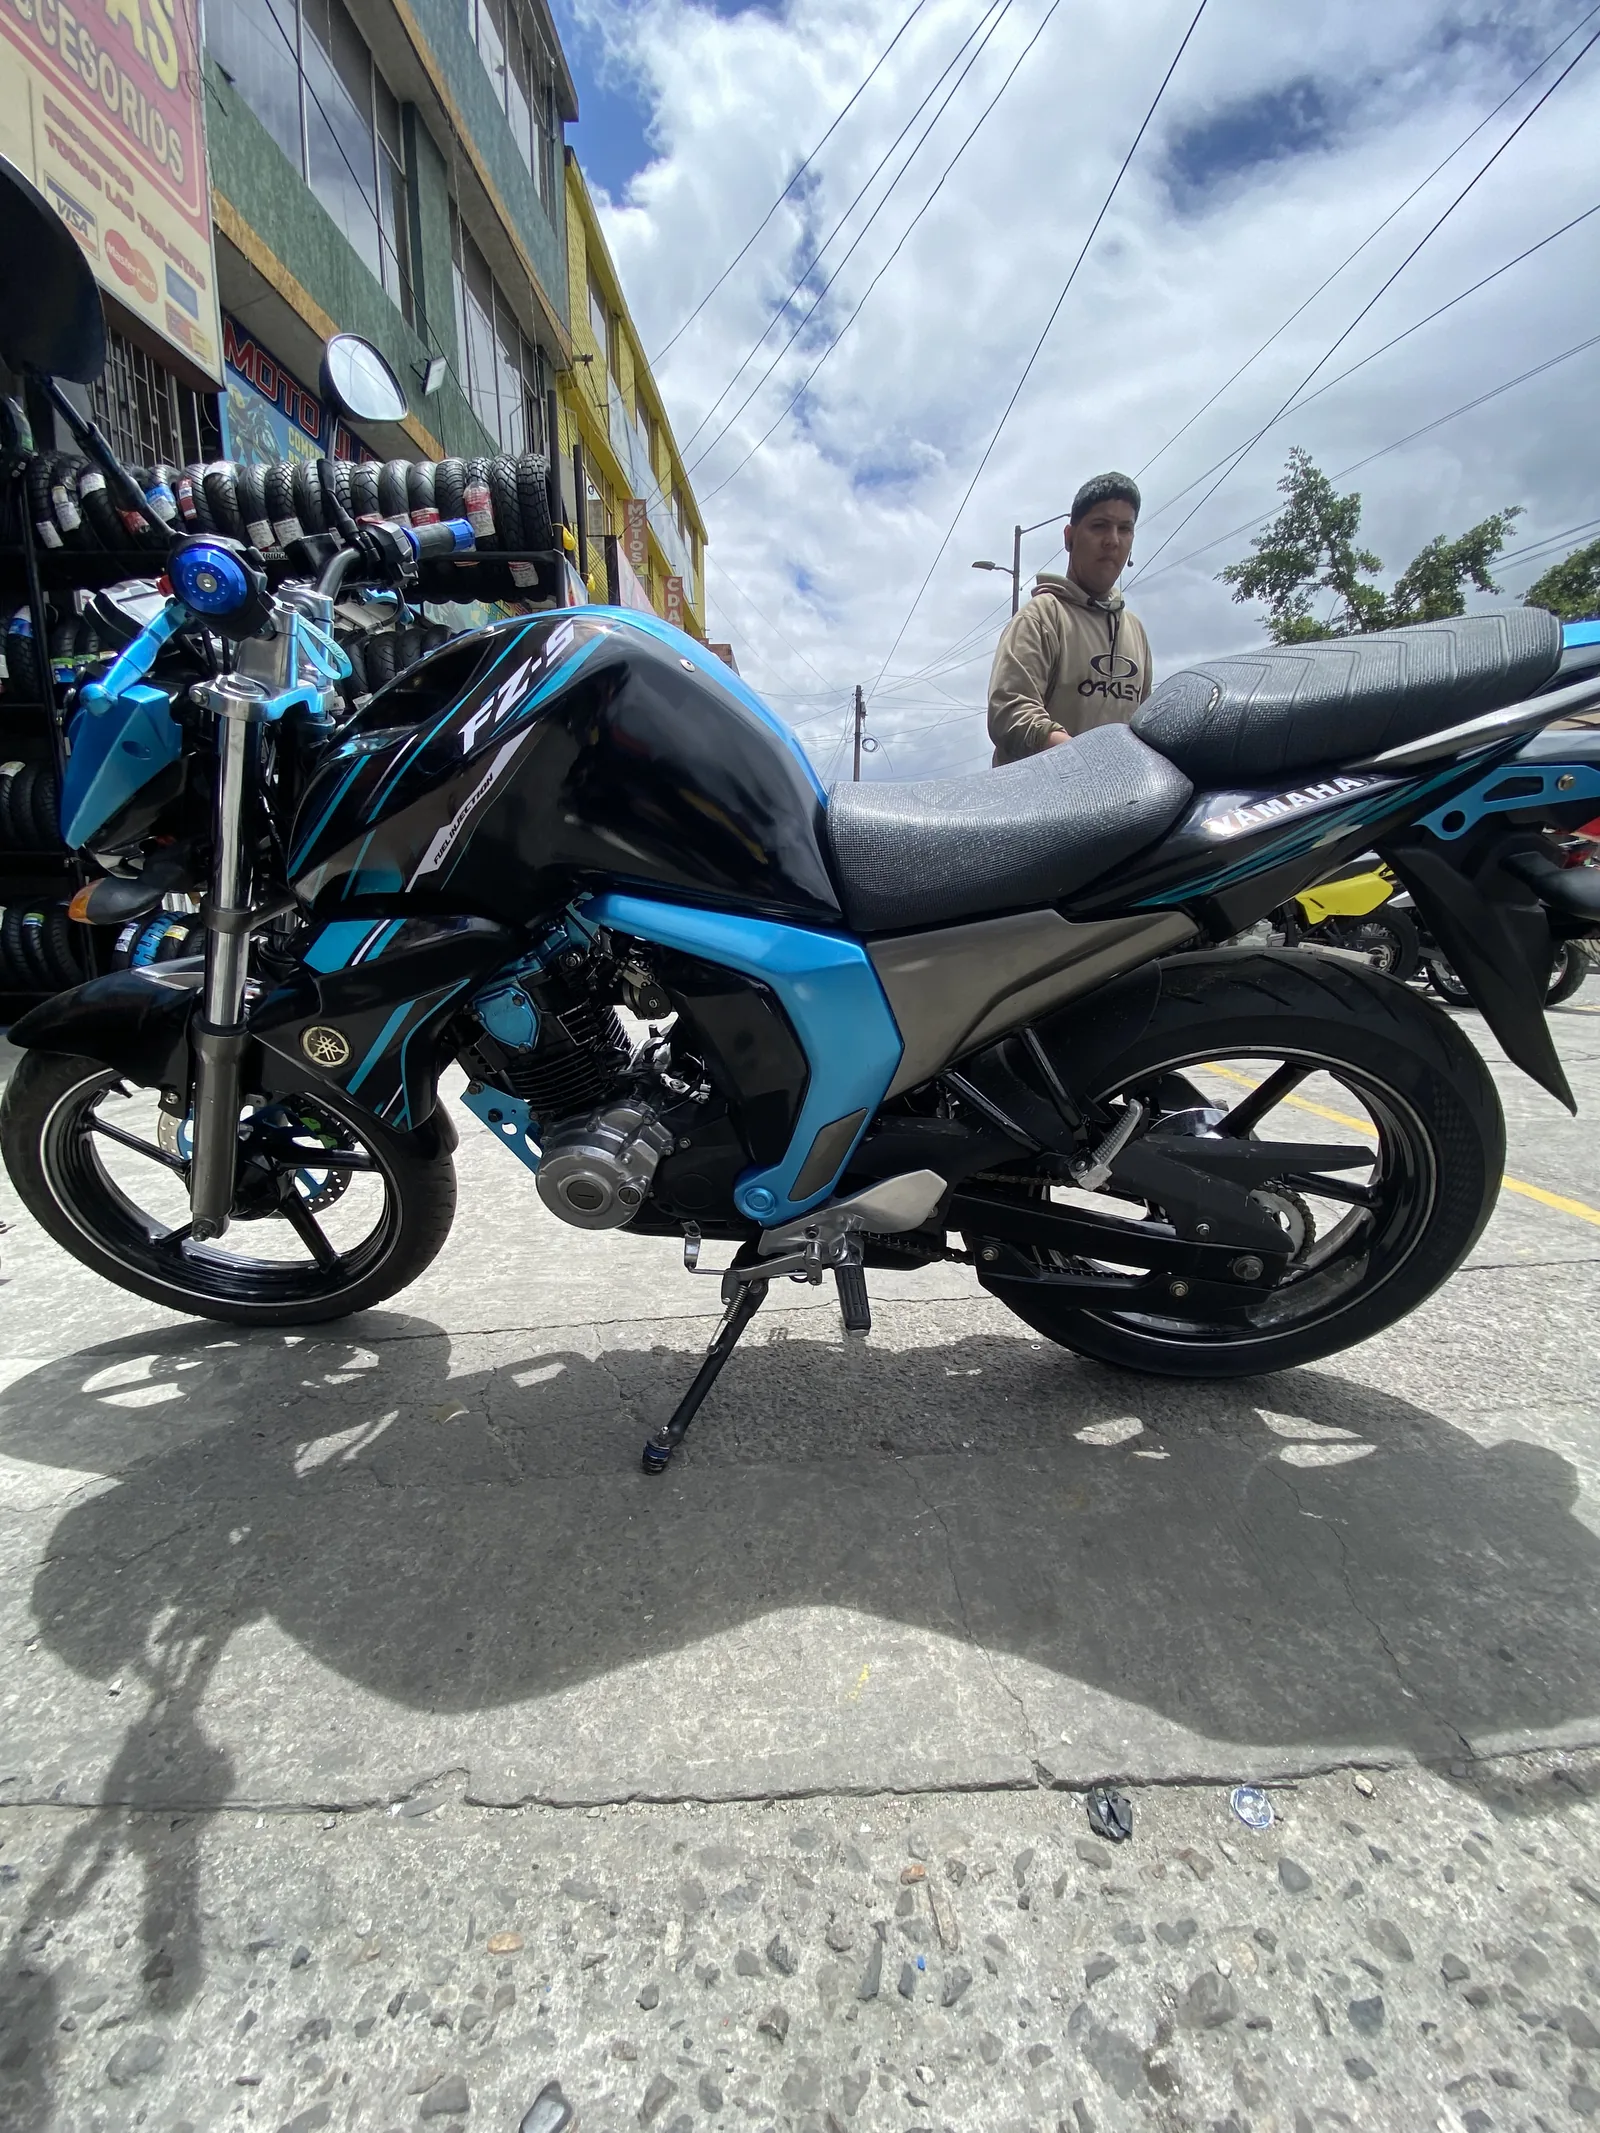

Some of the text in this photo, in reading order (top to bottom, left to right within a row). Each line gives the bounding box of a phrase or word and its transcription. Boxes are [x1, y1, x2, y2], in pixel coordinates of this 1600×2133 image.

[56, 197, 89, 238] VISA
[224, 318, 319, 439] MOTO
[627, 504, 645, 562] MOTOS
[458, 617, 575, 755] FZ-S
[1078, 678, 1141, 703] OAKLEY
[434, 772, 494, 865] FUEL INJECTION
[1208, 776, 1364, 834] YAMAHA
